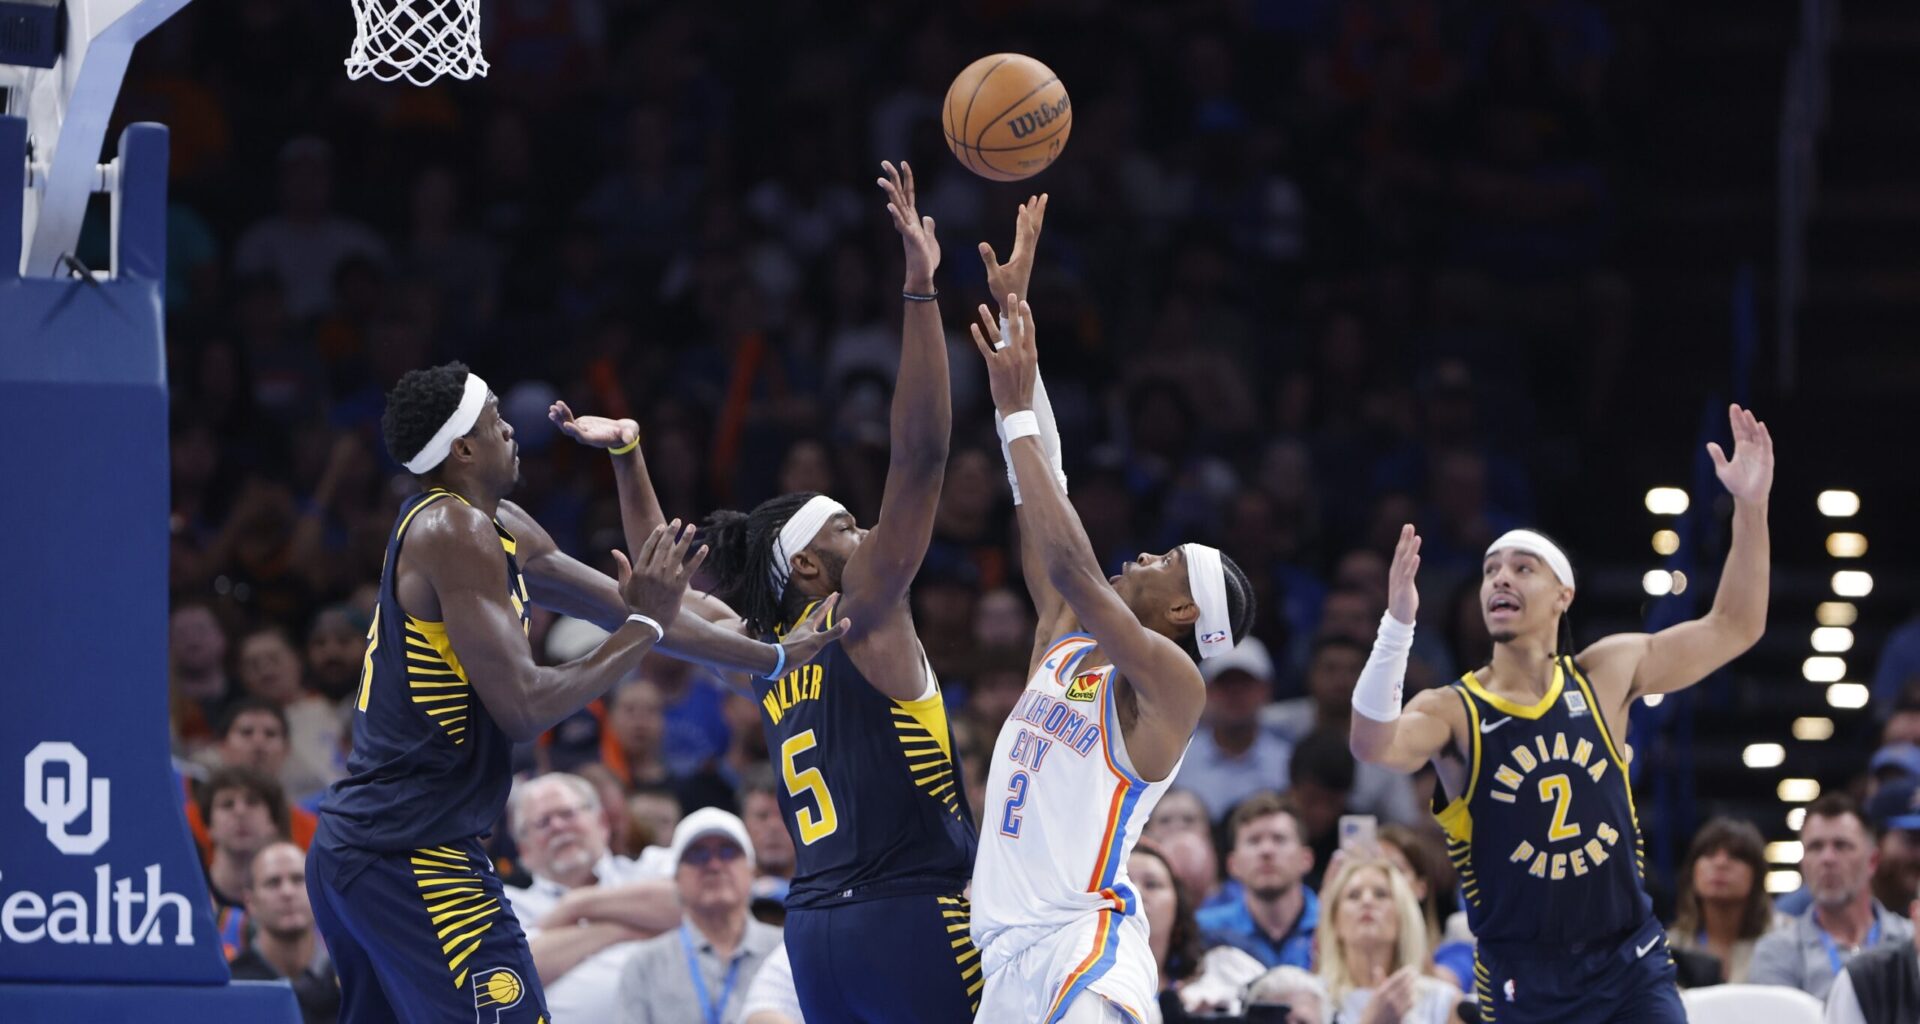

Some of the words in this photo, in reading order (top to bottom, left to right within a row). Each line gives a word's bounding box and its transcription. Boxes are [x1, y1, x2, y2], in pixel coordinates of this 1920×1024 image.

[1008, 94, 1070, 139] Wilson
[762, 663, 824, 726] WLKER
[1069, 688, 1094, 699] Love's
[24, 741, 110, 854] OU
[781, 728, 838, 846] 5
[1490, 732, 1609, 804] INDIANA
[1000, 770, 1030, 839] 2
[1537, 773, 1582, 843] 2
[1509, 822, 1620, 880] PACERS
[0, 862, 195, 946] ealth
